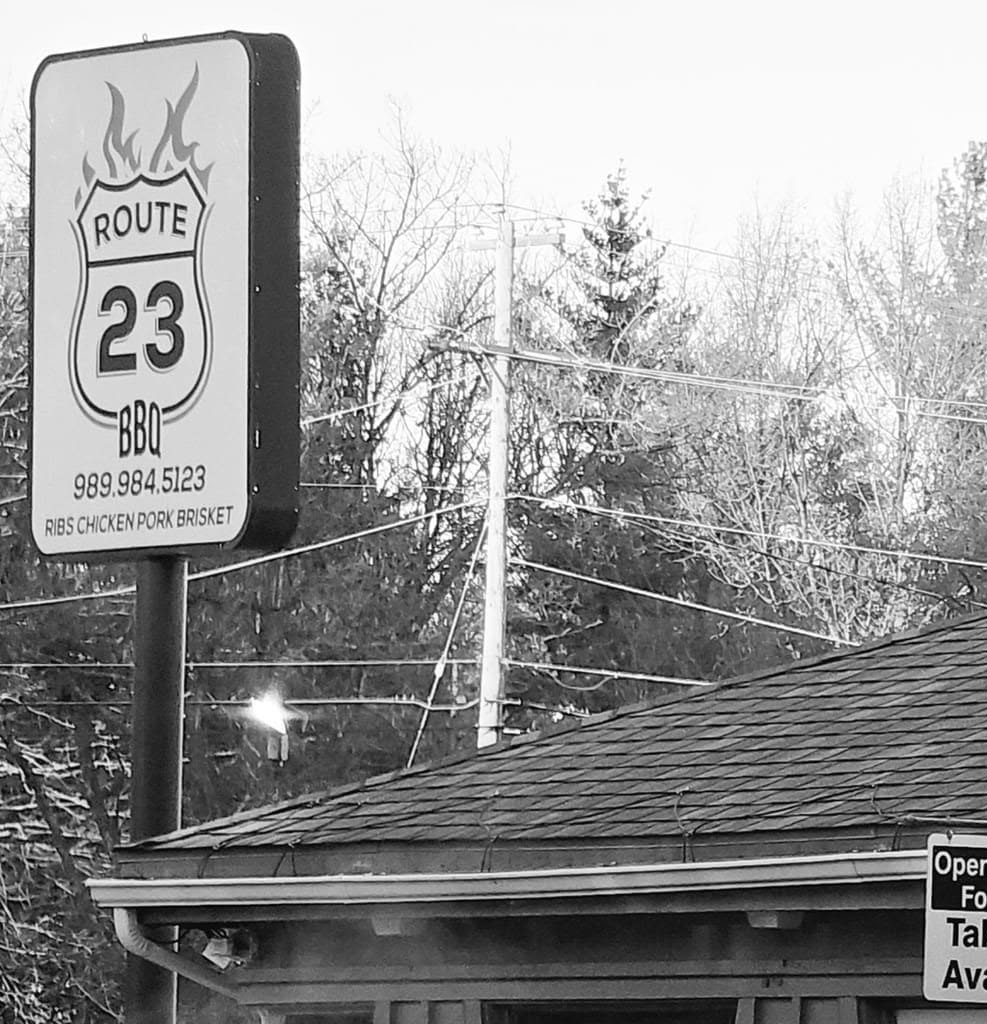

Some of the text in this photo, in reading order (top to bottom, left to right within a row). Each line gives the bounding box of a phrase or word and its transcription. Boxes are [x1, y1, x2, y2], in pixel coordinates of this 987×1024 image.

[95, 201, 188, 245] ROUTE
[98, 280, 185, 376] 23
[118, 399, 162, 459] BBQ
[74, 465, 206, 500] 989.984.5123
[45, 505, 234, 537] RIBS CHICKEN PORK BRISKET
